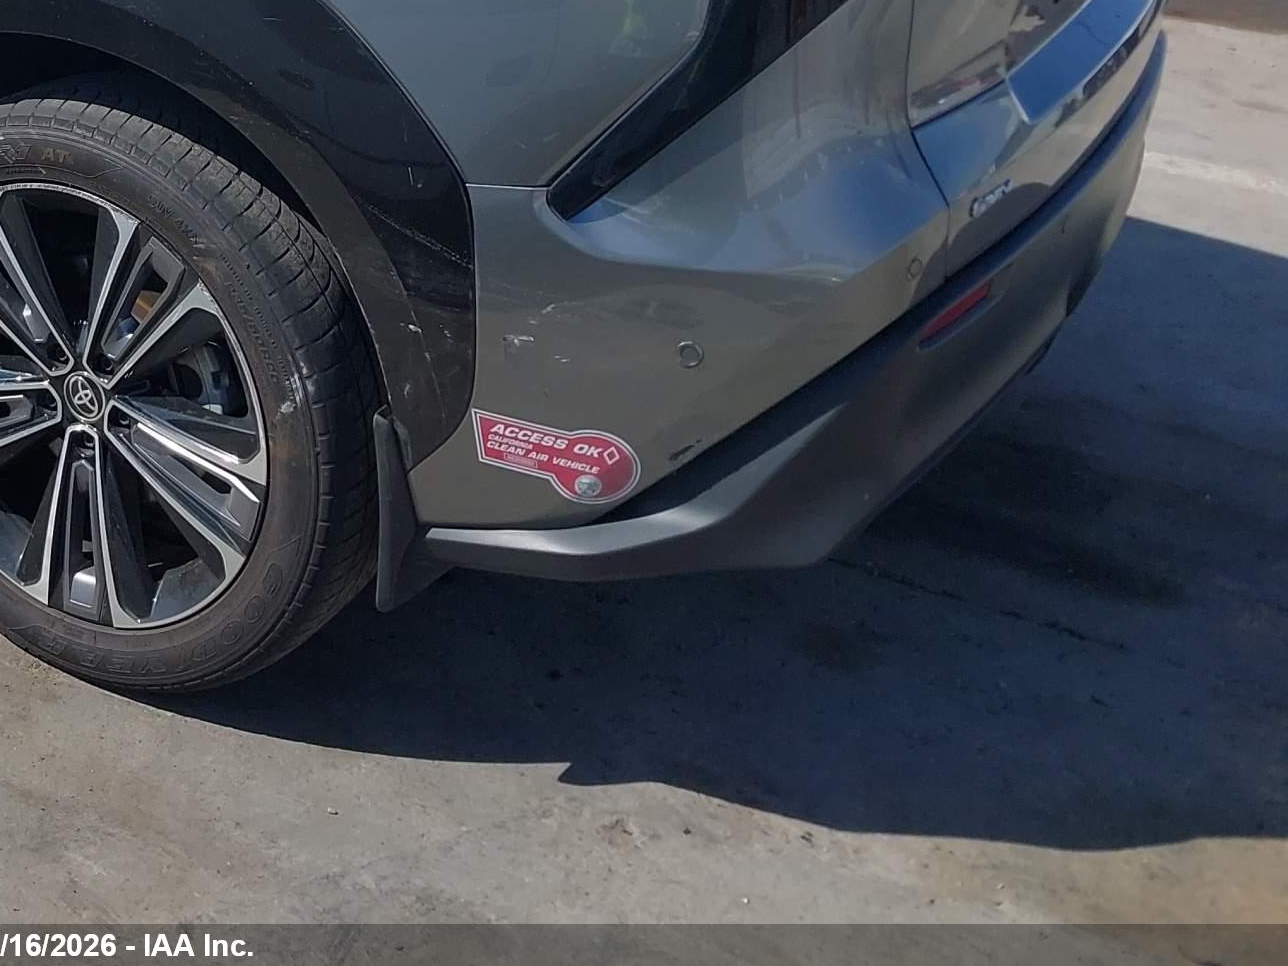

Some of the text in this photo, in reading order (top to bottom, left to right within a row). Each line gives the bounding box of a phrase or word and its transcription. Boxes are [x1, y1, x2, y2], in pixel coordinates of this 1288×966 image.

[487, 441, 525, 456] CLEAN
[528, 452, 549, 462] AIR
[553, 458, 600, 474] VEHICLE
[488, 434, 533, 449] CALIFORNIA
[490, 424, 604, 458] ACCESS OK
